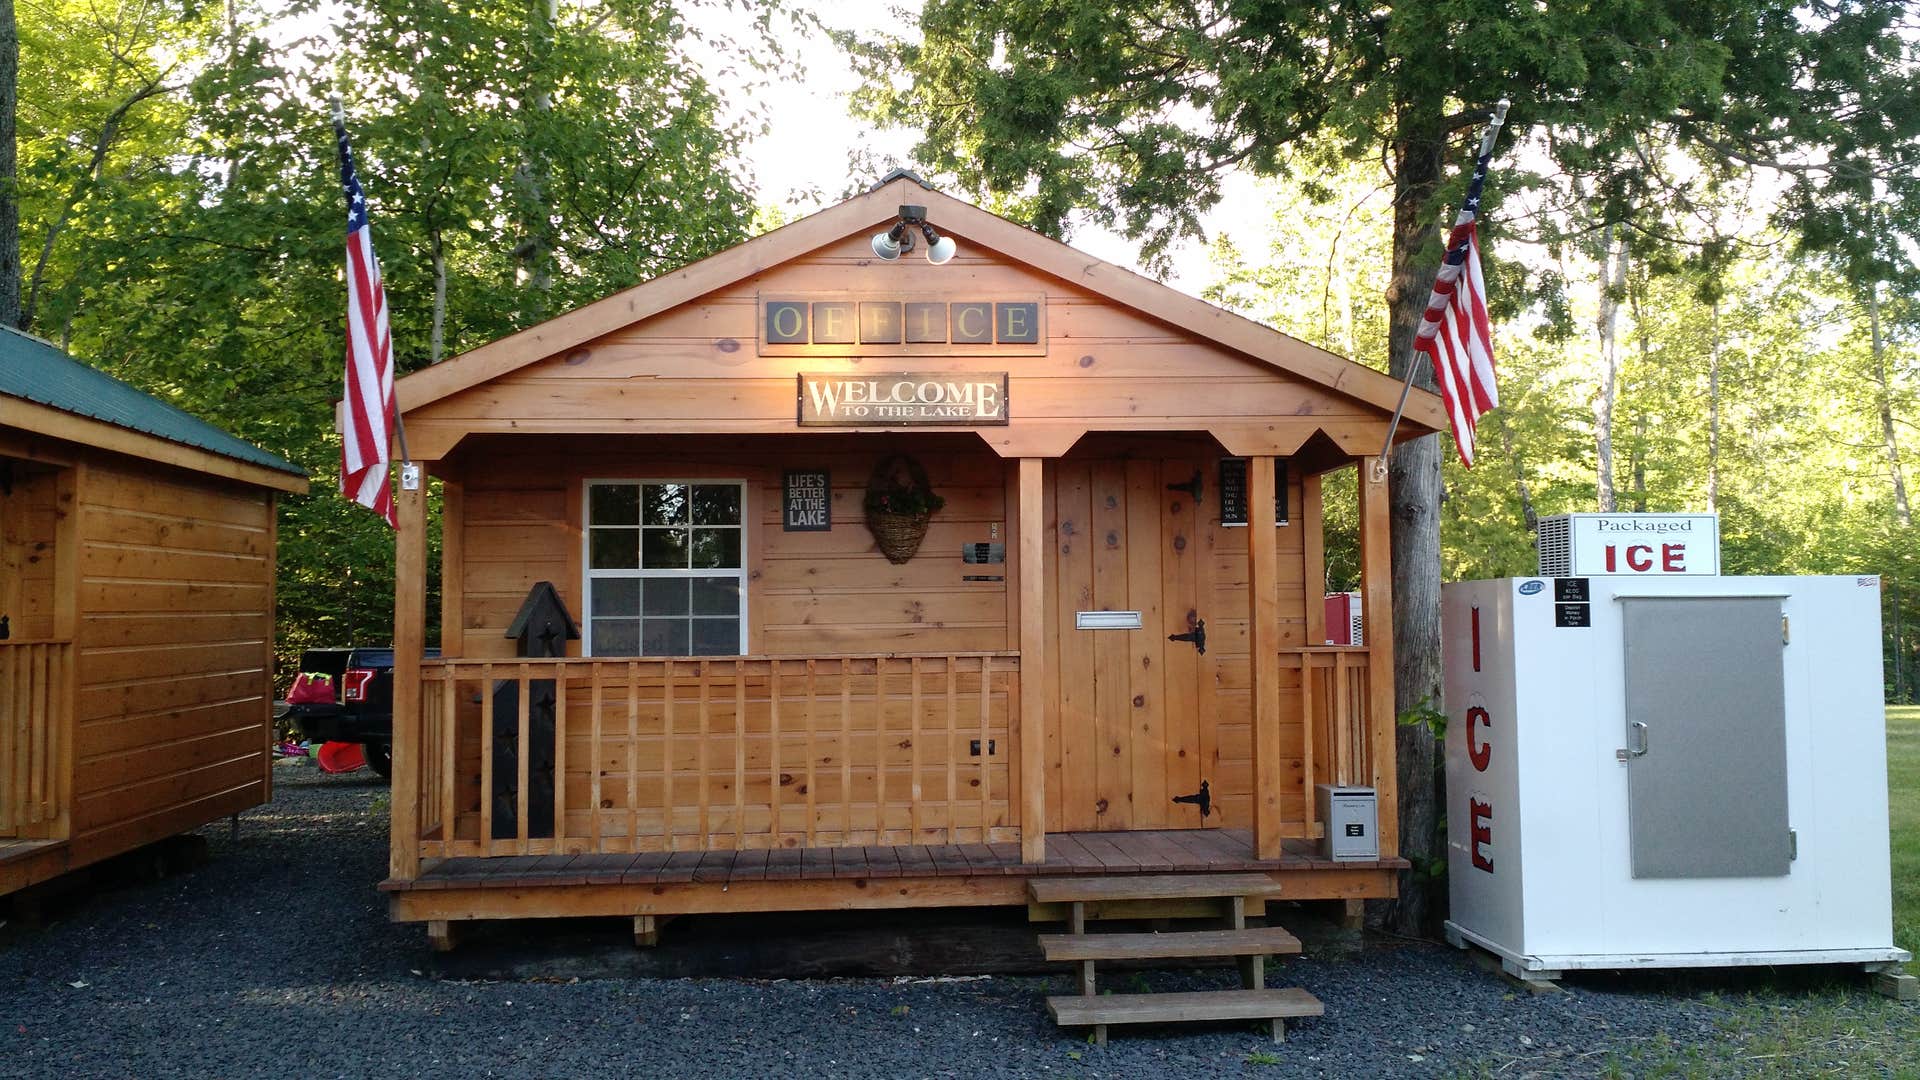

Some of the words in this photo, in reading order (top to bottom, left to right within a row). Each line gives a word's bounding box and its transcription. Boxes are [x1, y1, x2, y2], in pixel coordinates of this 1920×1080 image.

[774, 306, 1029, 338] OFFICE
[807, 380, 999, 417] WELCOME
[841, 405, 873, 417] TO
[875, 405, 914, 417] THE
[920, 405, 971, 417] LAKE
[789, 474, 825, 487] LIFE'S
[789, 487, 825, 498] BETTER
[790, 498, 803, 510] AT
[804, 498, 825, 510] THE
[790, 510, 826, 526] LAKE
[1598, 519, 1692, 534] Packaged
[1605, 541, 1687, 573] ICE
[1466, 604, 1493, 875] ICE
